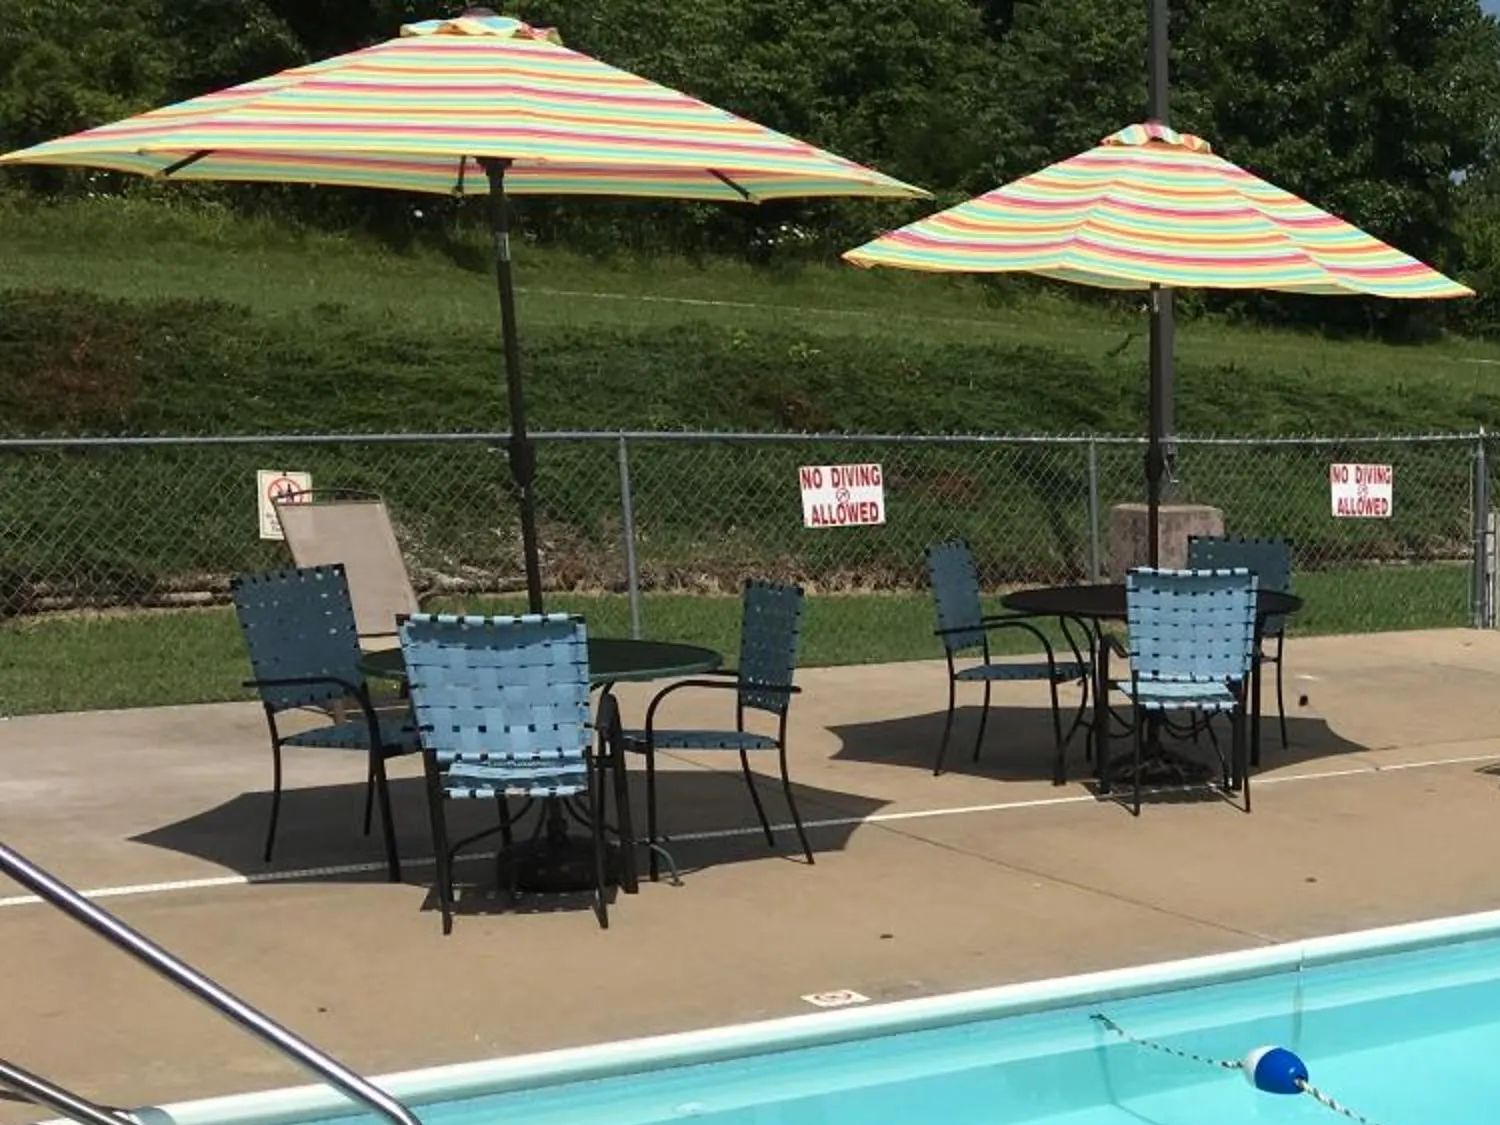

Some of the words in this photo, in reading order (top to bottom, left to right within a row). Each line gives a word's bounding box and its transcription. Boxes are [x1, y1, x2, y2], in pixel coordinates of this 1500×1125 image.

[801, 466, 823, 490] NO
[830, 465, 881, 489] DIVING
[1330, 465, 1349, 484] NO
[1355, 465, 1391, 485] DIVING
[812, 501, 880, 525] ALLOWED
[1337, 496, 1389, 515] ALLOWED
